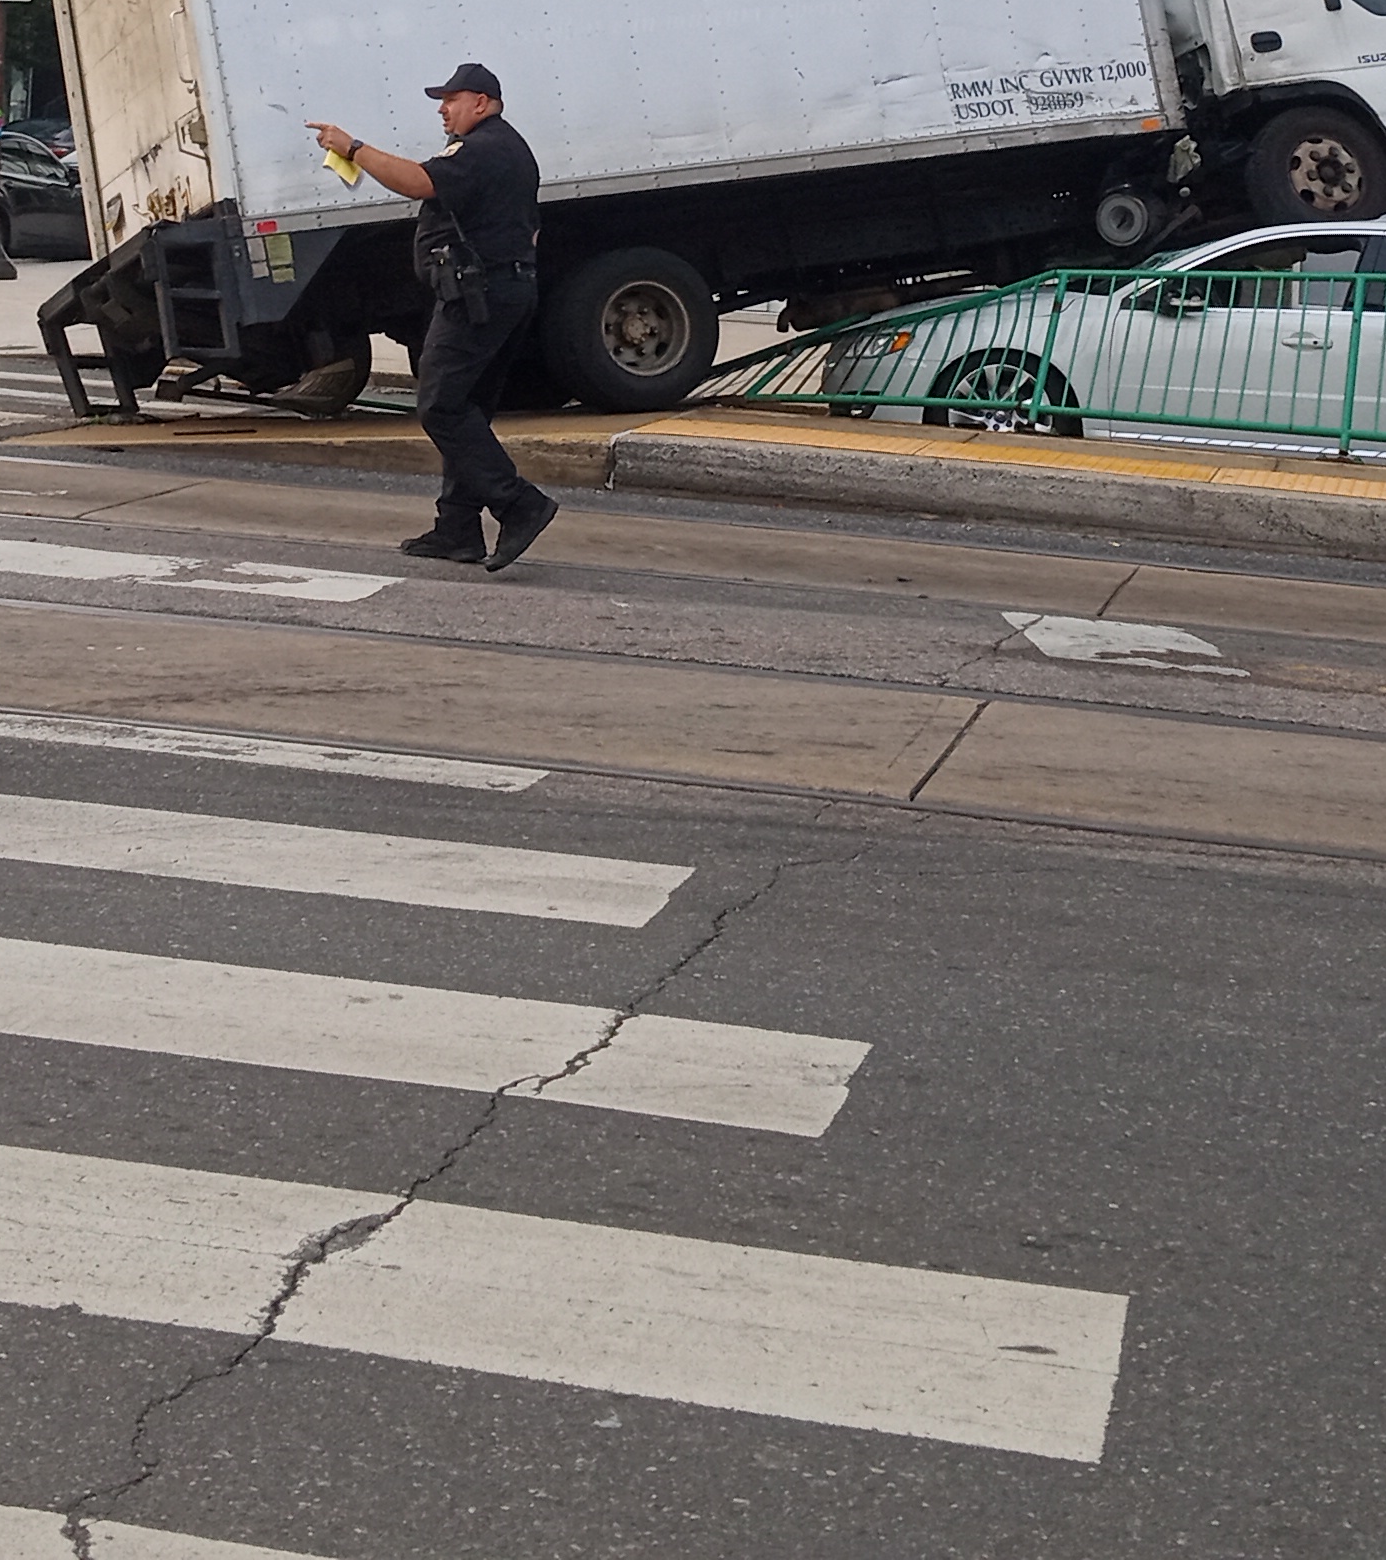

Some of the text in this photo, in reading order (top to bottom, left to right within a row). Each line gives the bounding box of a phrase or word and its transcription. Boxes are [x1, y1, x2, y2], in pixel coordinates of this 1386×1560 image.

[950, 60, 1147, 100] RMW INC GVWR 12,000
